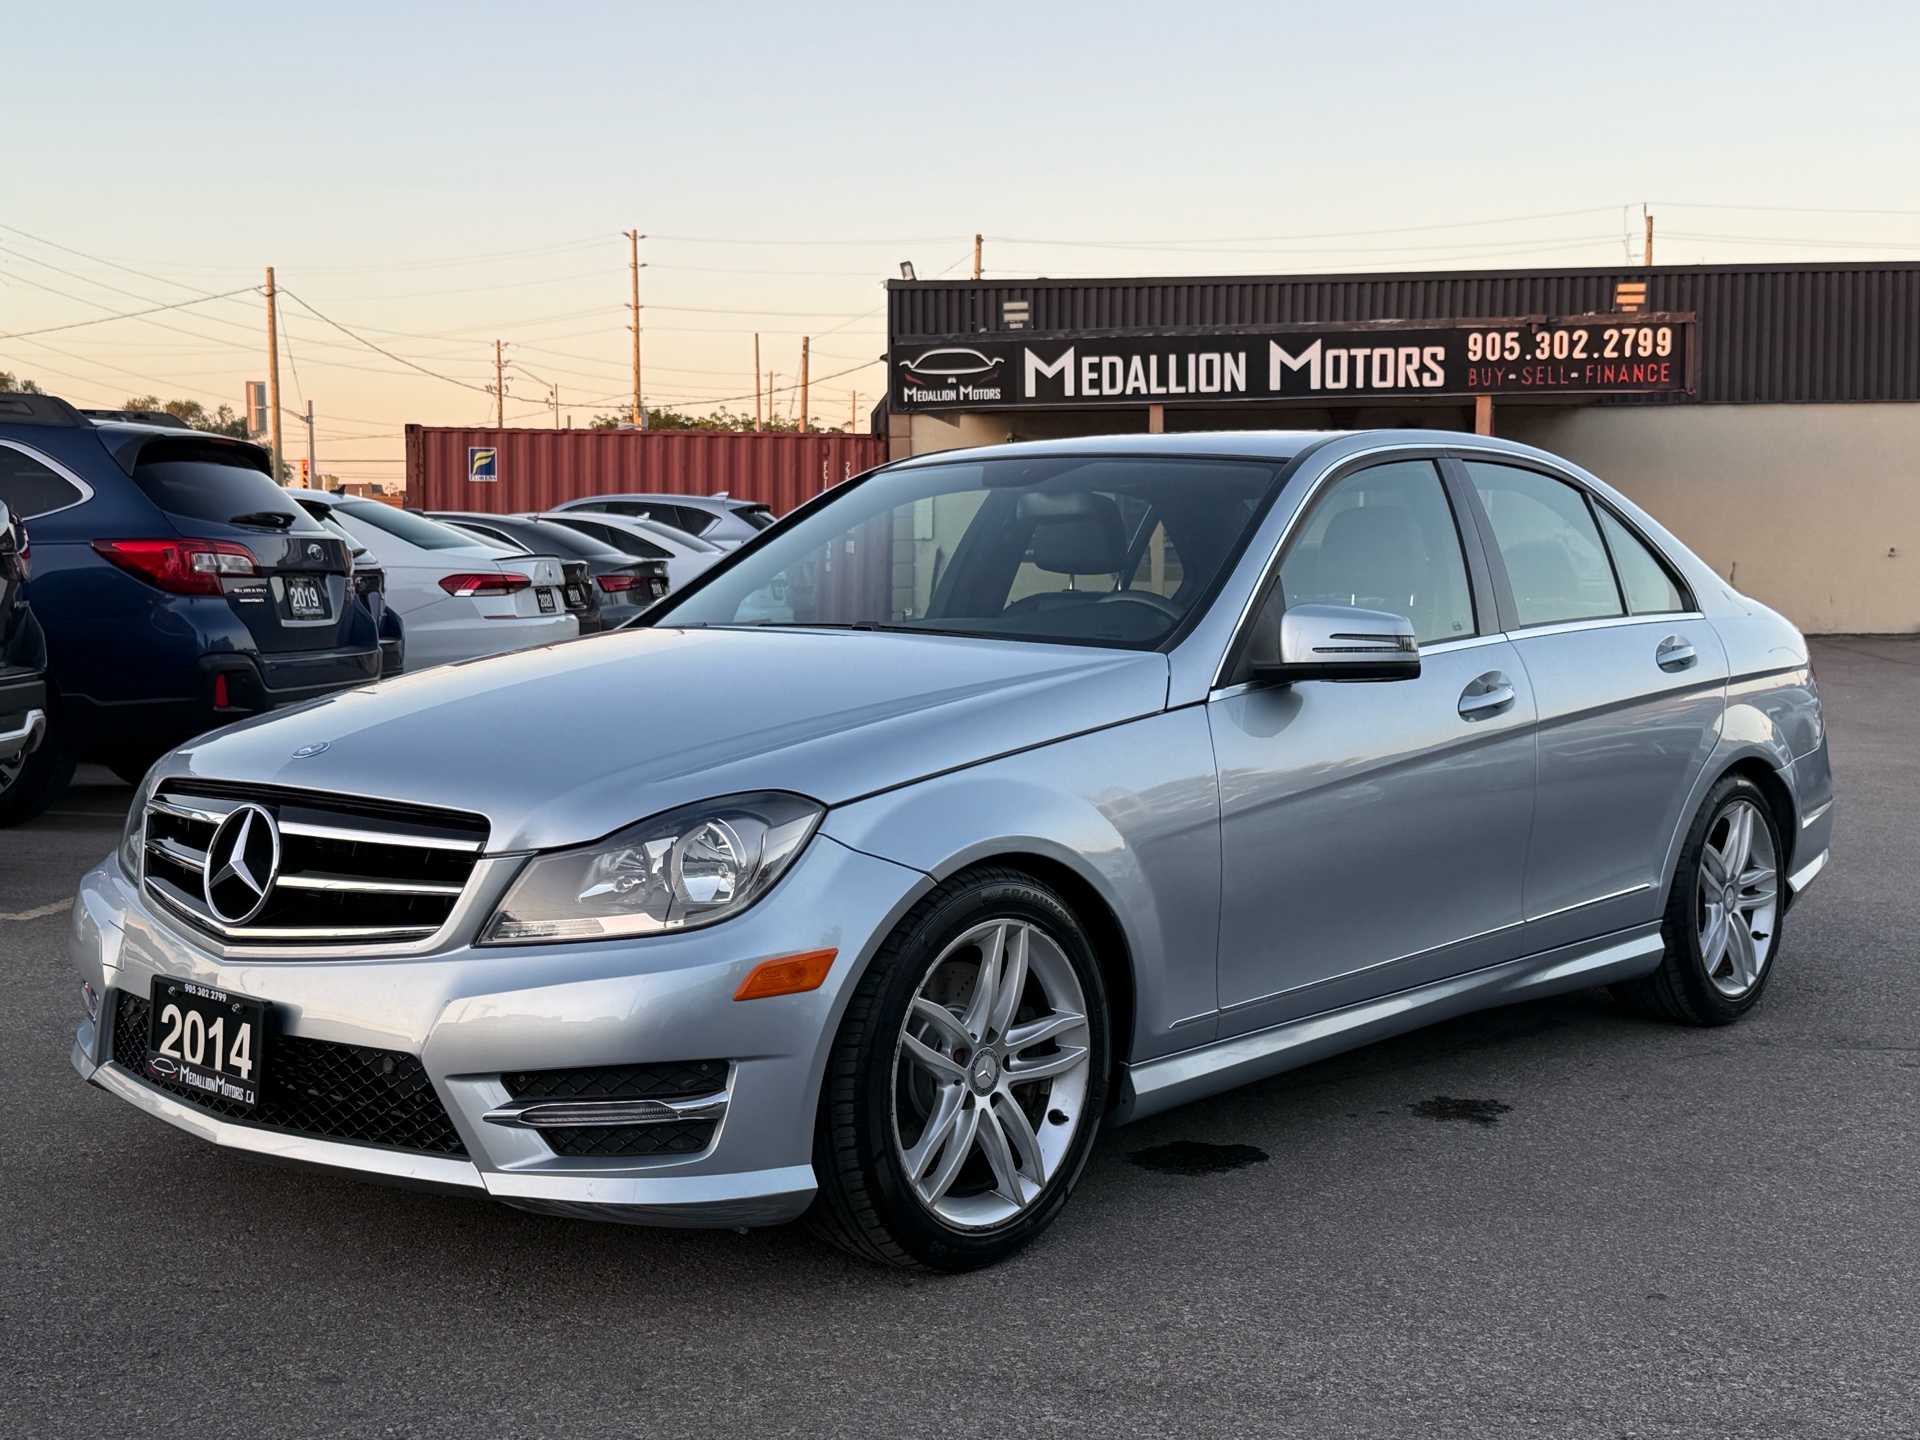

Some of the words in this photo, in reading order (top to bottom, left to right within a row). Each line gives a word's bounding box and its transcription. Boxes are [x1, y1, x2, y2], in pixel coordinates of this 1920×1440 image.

[1467, 327, 1672, 362] 905.302.2799
[1024, 346, 1246, 397] MEDALLION
[1269, 338, 1445, 391] MOTORS
[903, 386, 957, 402] MEDALLION
[959, 385, 1001, 401] MOTORS
[290, 587, 319, 608] 2019
[159, 1003, 253, 1080] 2014
